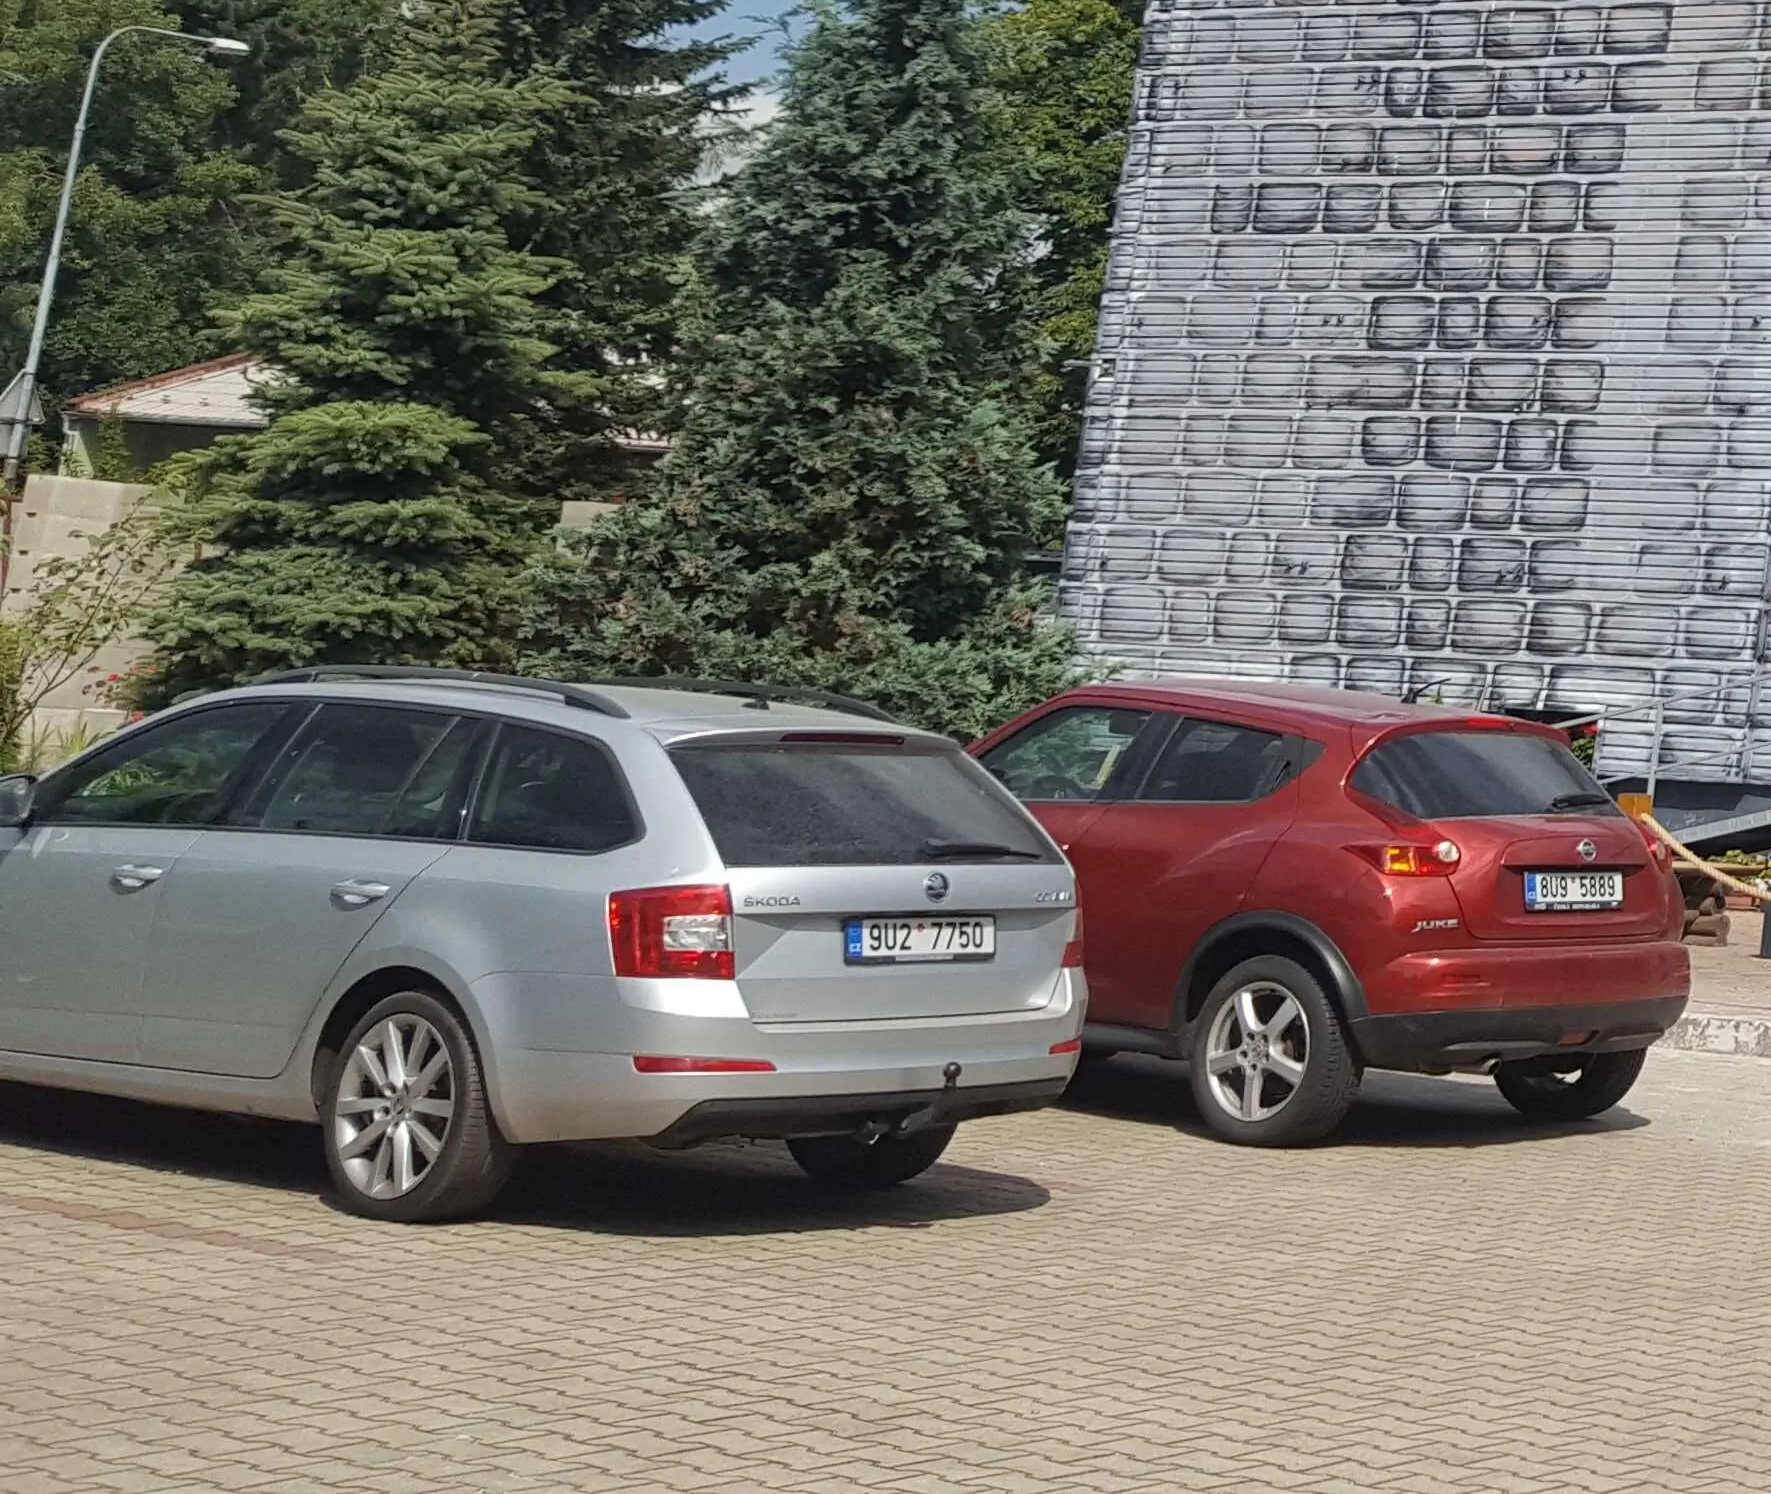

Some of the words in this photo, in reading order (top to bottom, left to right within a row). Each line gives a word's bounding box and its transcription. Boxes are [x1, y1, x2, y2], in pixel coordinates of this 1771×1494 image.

[1540, 876, 1568, 898] 8U9
[1580, 875, 1615, 898] 5889
[743, 895, 801, 907] ŠKODA
[1411, 919, 1459, 933] JUKE
[869, 922, 912, 952] 9U2
[931, 921, 984, 950] 7750
